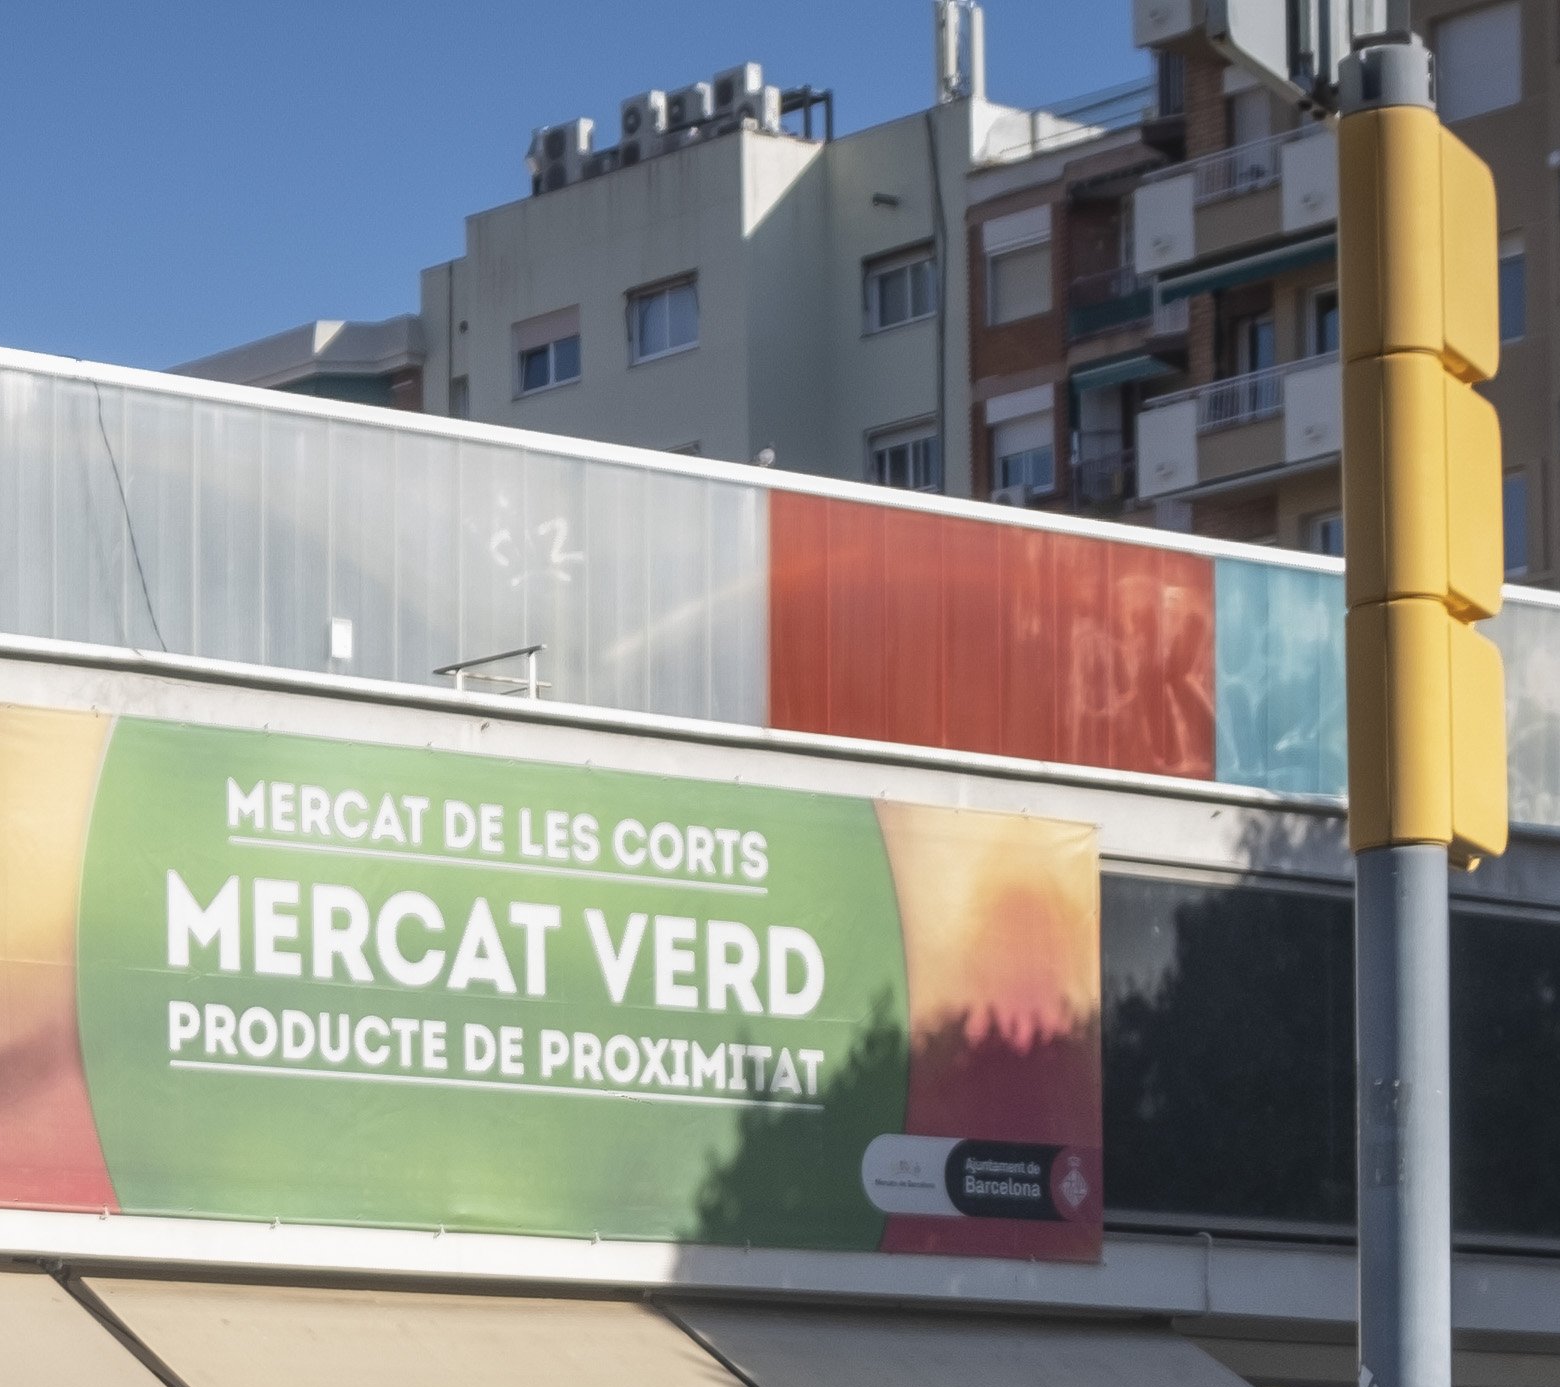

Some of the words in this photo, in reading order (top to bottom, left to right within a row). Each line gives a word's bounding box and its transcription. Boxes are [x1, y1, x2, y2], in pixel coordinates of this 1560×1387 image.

[226, 777, 431, 846] MERCAT
[443, 798, 506, 855] DE
[518, 806, 601, 864] LES
[612, 818, 769, 881] CORTS
[166, 869, 562, 998] MERCAT
[584, 908, 827, 1017] VERD
[168, 1001, 449, 1071] PRODUCTE
[464, 1023, 526, 1076] DE
[540, 1029, 825, 1096] PROXIMITAT
[965, 1157, 1025, 1174] Ajuntament
[1027, 1161, 1041, 1175] de
[965, 1175, 1041, 1197] Barcelona
